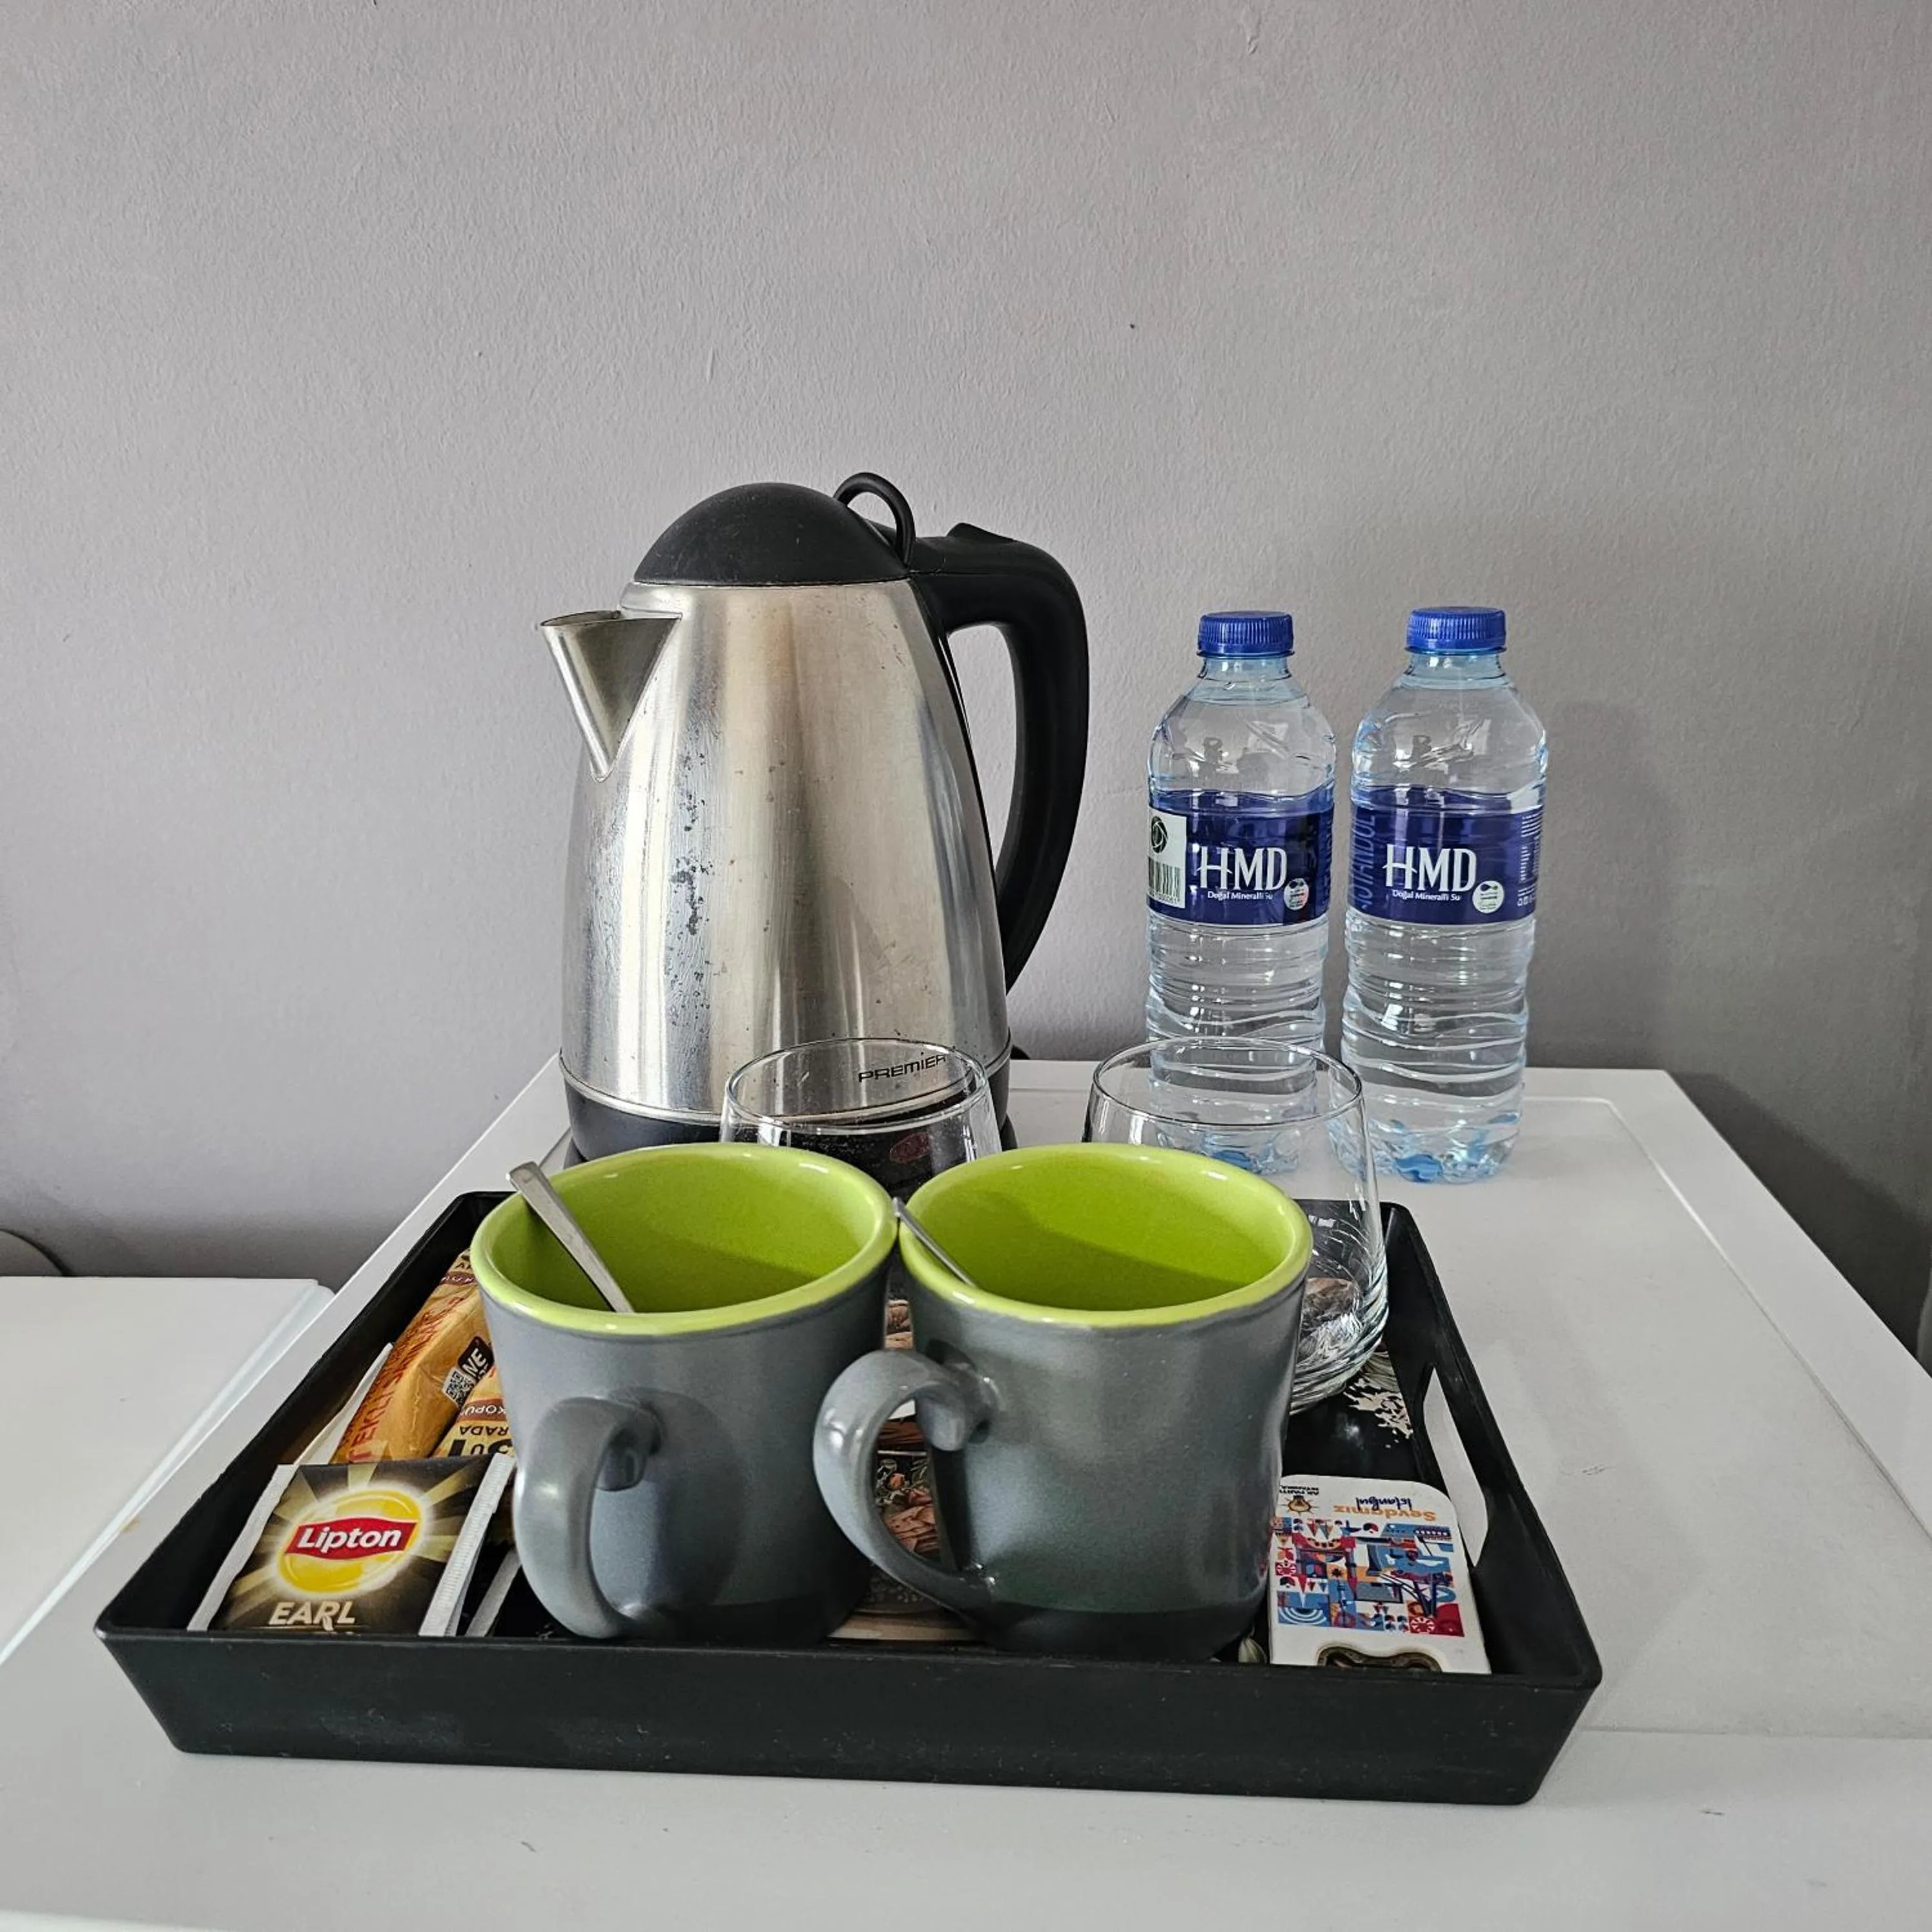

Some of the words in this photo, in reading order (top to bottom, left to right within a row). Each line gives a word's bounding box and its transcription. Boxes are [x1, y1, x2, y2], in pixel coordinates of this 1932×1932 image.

[1197, 846, 1287, 890] HMD
[1382, 844, 1477, 892] HMD
[460, 1426, 509, 1436] RADA
[297, 1526, 402, 1553] Lipton
[269, 1601, 356, 1631] EARL
